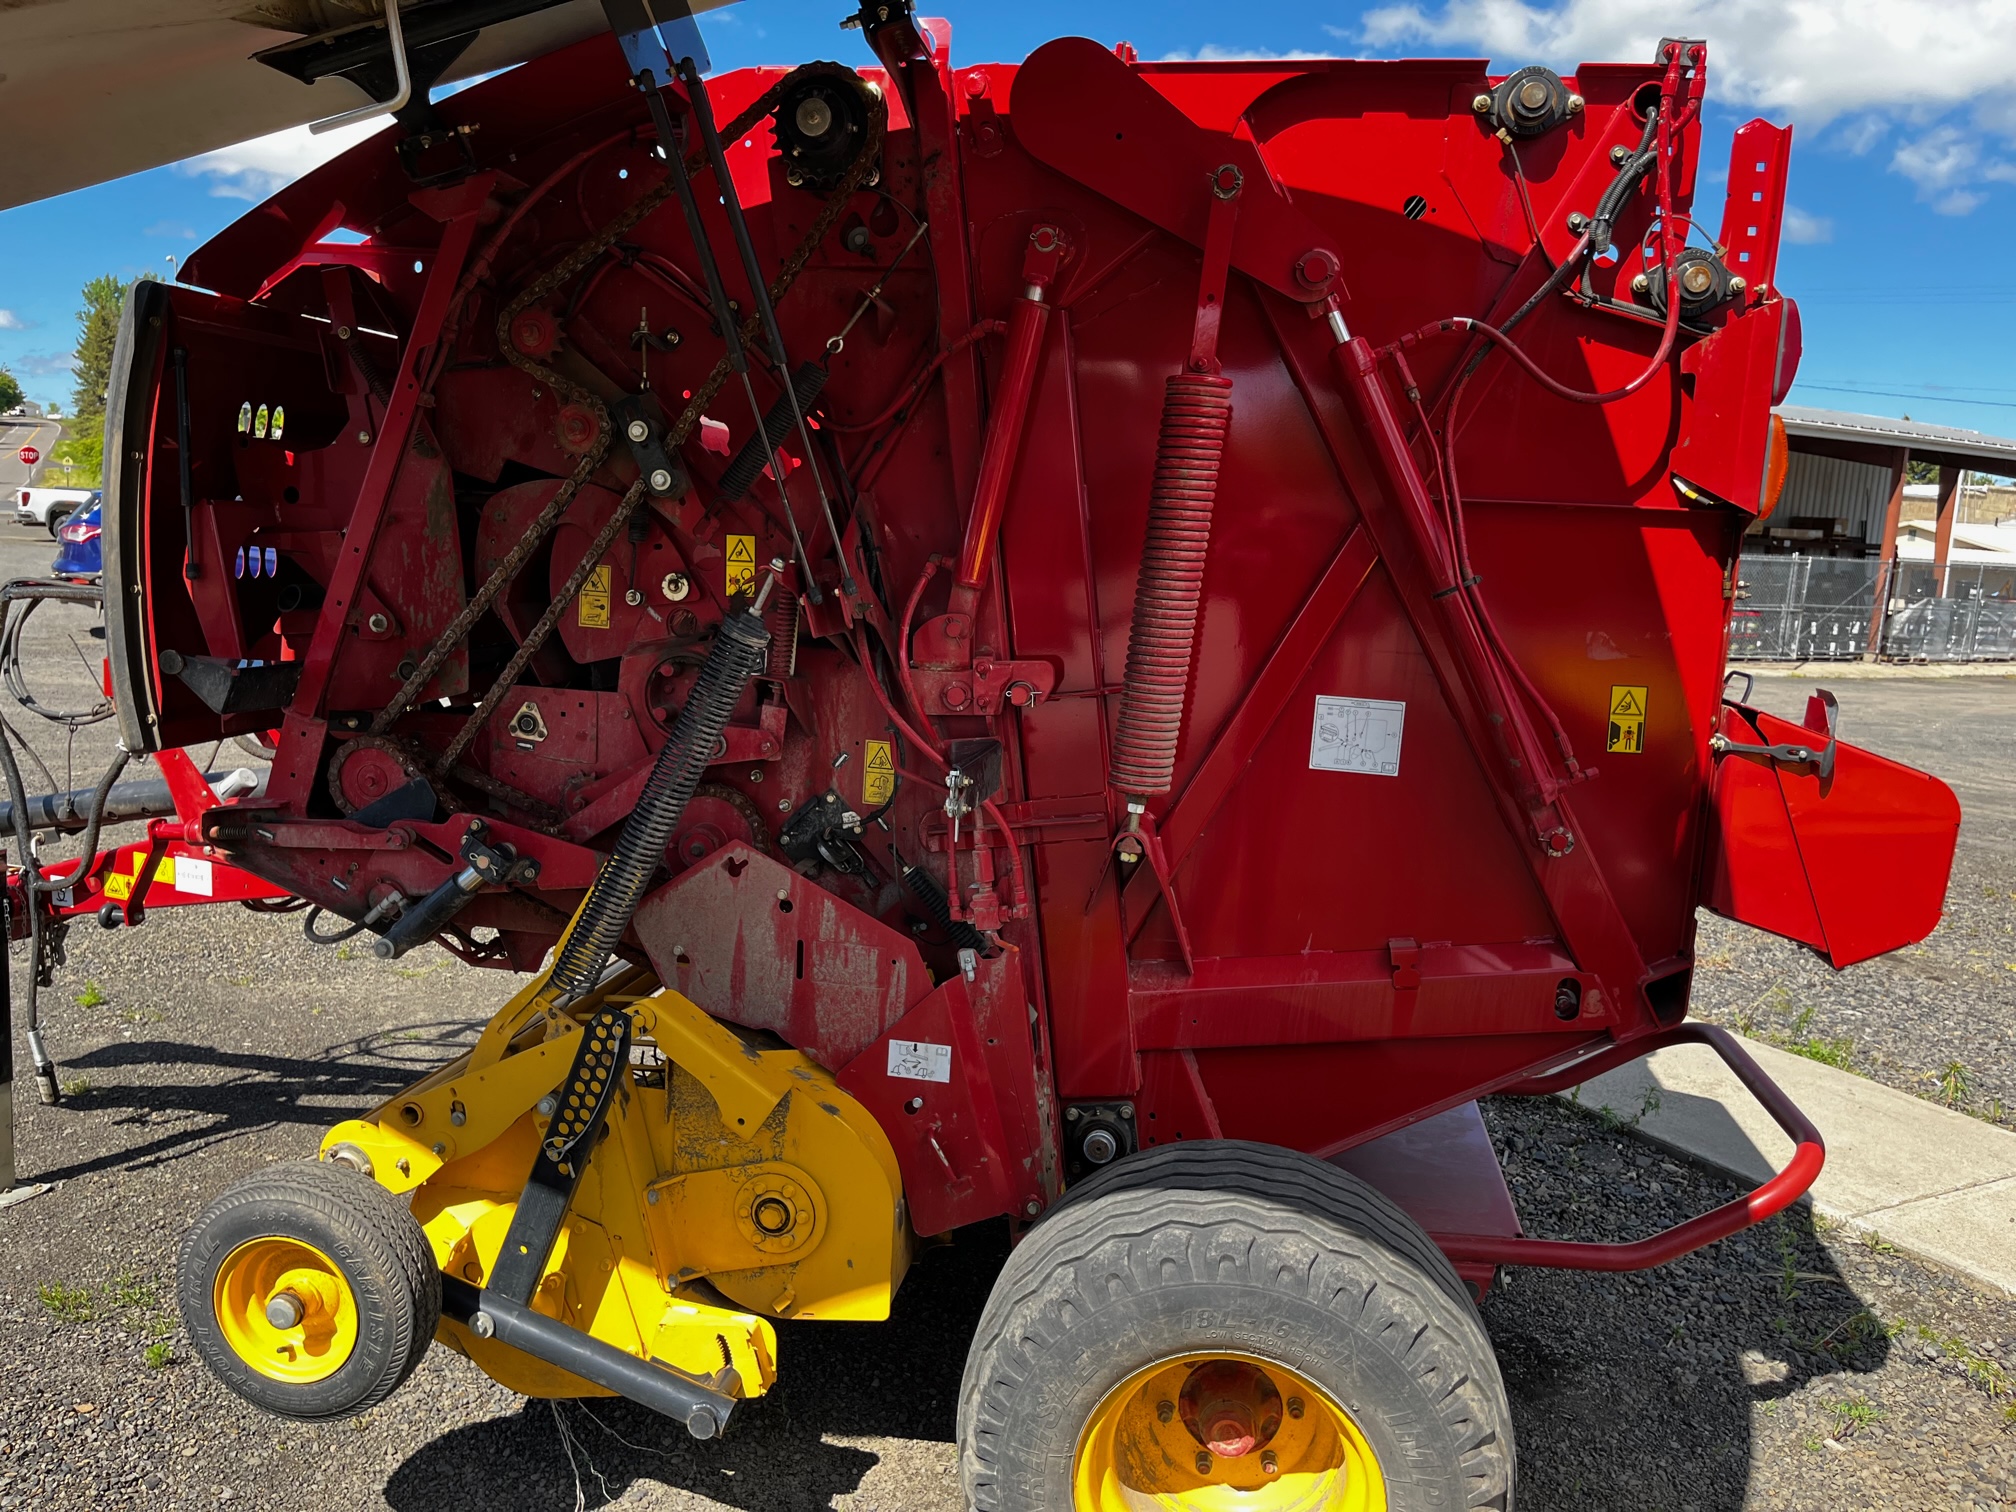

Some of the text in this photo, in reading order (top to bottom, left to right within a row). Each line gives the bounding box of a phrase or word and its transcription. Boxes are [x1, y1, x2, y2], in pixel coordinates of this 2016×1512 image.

[20, 451, 39, 460] STOP
[188, 1235, 261, 1398] SPORT TRAIL
[334, 1240, 385, 1377] CARLISLE
[1204, 1330, 1227, 1339] LOW
[1234, 1331, 1282, 1348] SECTION
[1288, 1345, 1326, 1369] HEIGHT
